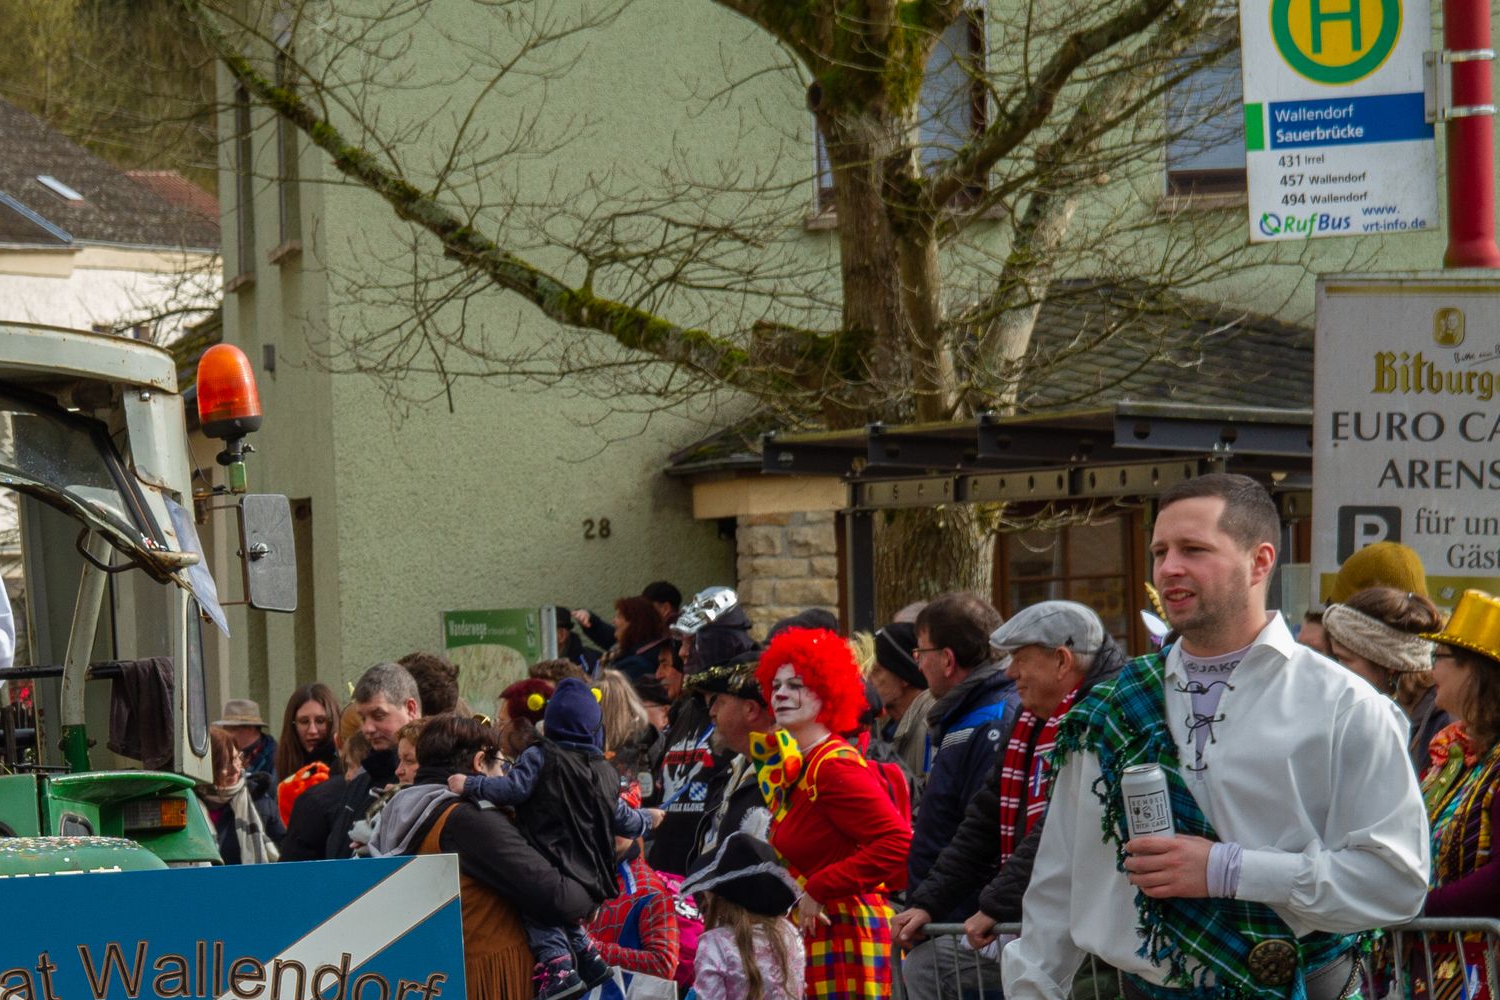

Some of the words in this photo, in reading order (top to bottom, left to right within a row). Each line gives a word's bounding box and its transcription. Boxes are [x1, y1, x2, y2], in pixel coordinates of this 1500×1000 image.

[1275, 105, 1354, 123] Wallendorf
[1276, 125, 1364, 143] Sauerbrücke
[1278, 155, 1301, 167] 431
[1304, 154, 1325, 165] Irrel
[1280, 174, 1304, 187] 457
[1309, 172, 1367, 184] Wallendorf
[1281, 193, 1306, 206] 494
[1310, 192, 1368, 204] Wallendorf
[1363, 218, 1426, 232] vrt-info.de
[1331, 411, 1445, 443] EURO
[1377, 458, 1500, 490] ARENS
[582, 518, 611, 540] 28
[1414, 508, 1456, 535] für
